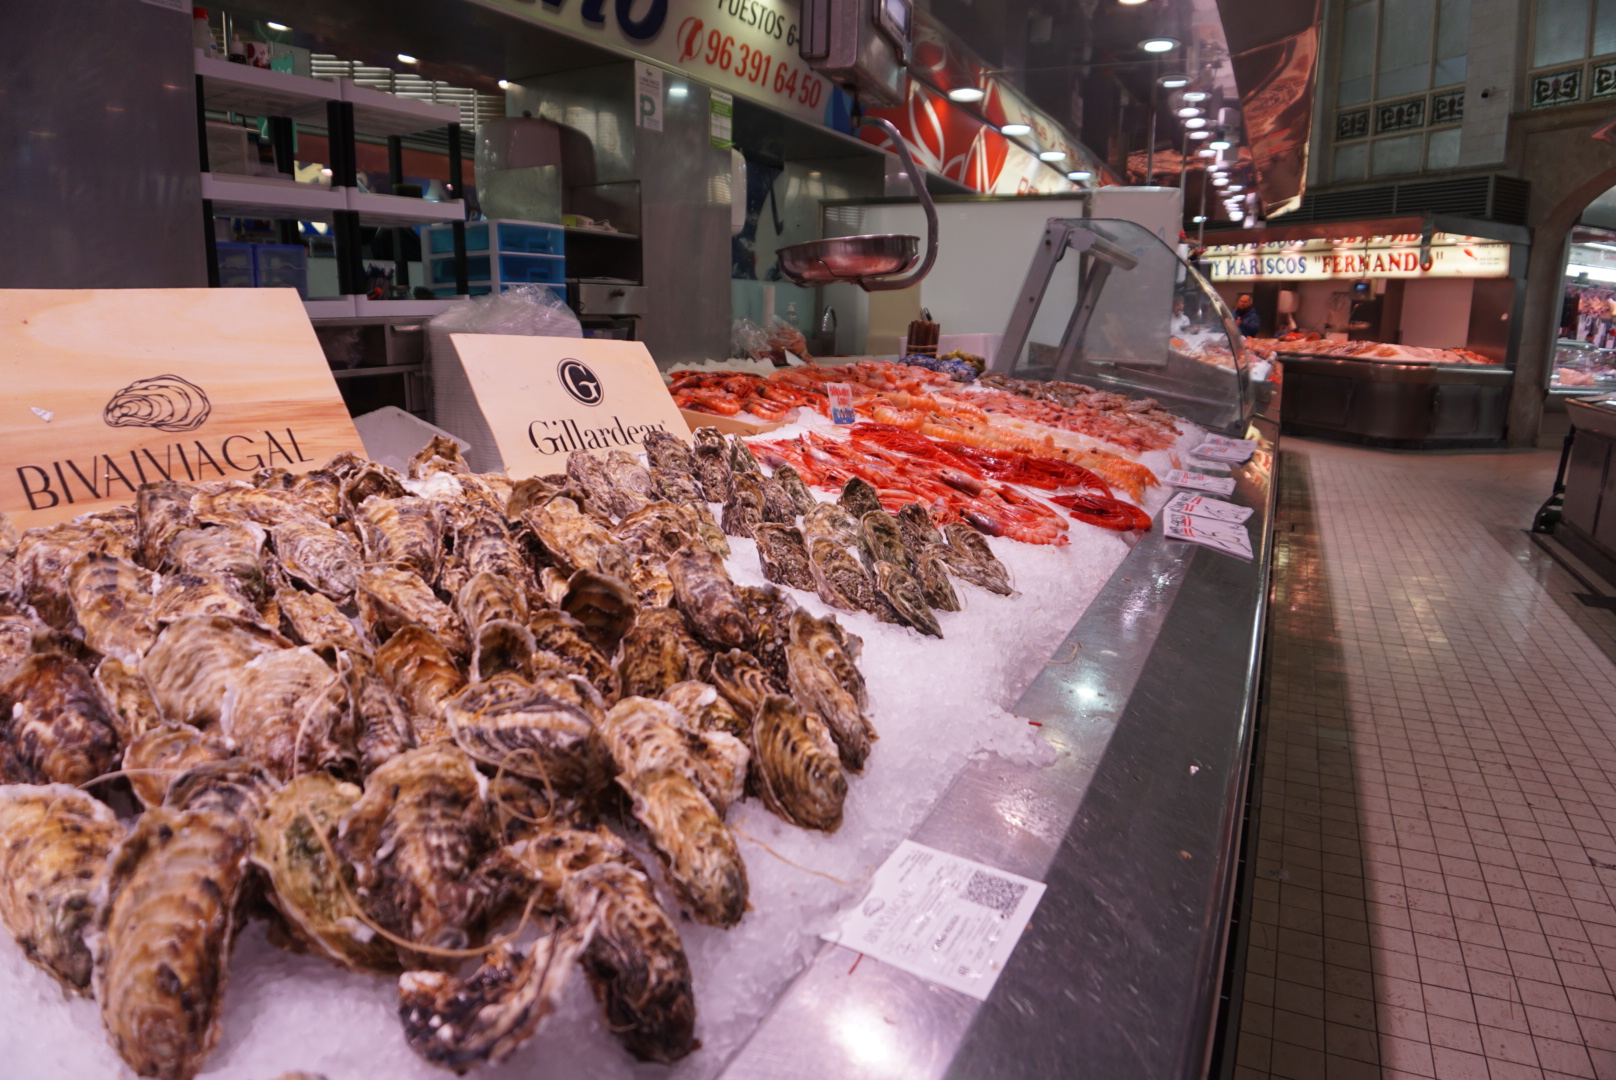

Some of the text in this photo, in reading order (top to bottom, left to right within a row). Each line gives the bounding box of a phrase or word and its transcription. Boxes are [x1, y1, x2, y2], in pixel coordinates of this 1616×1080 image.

[705, 28, 823, 109] 96 391 64 50
[1212, 260, 1224, 276] Y
[1226, 253, 1308, 276] MARISCOS
